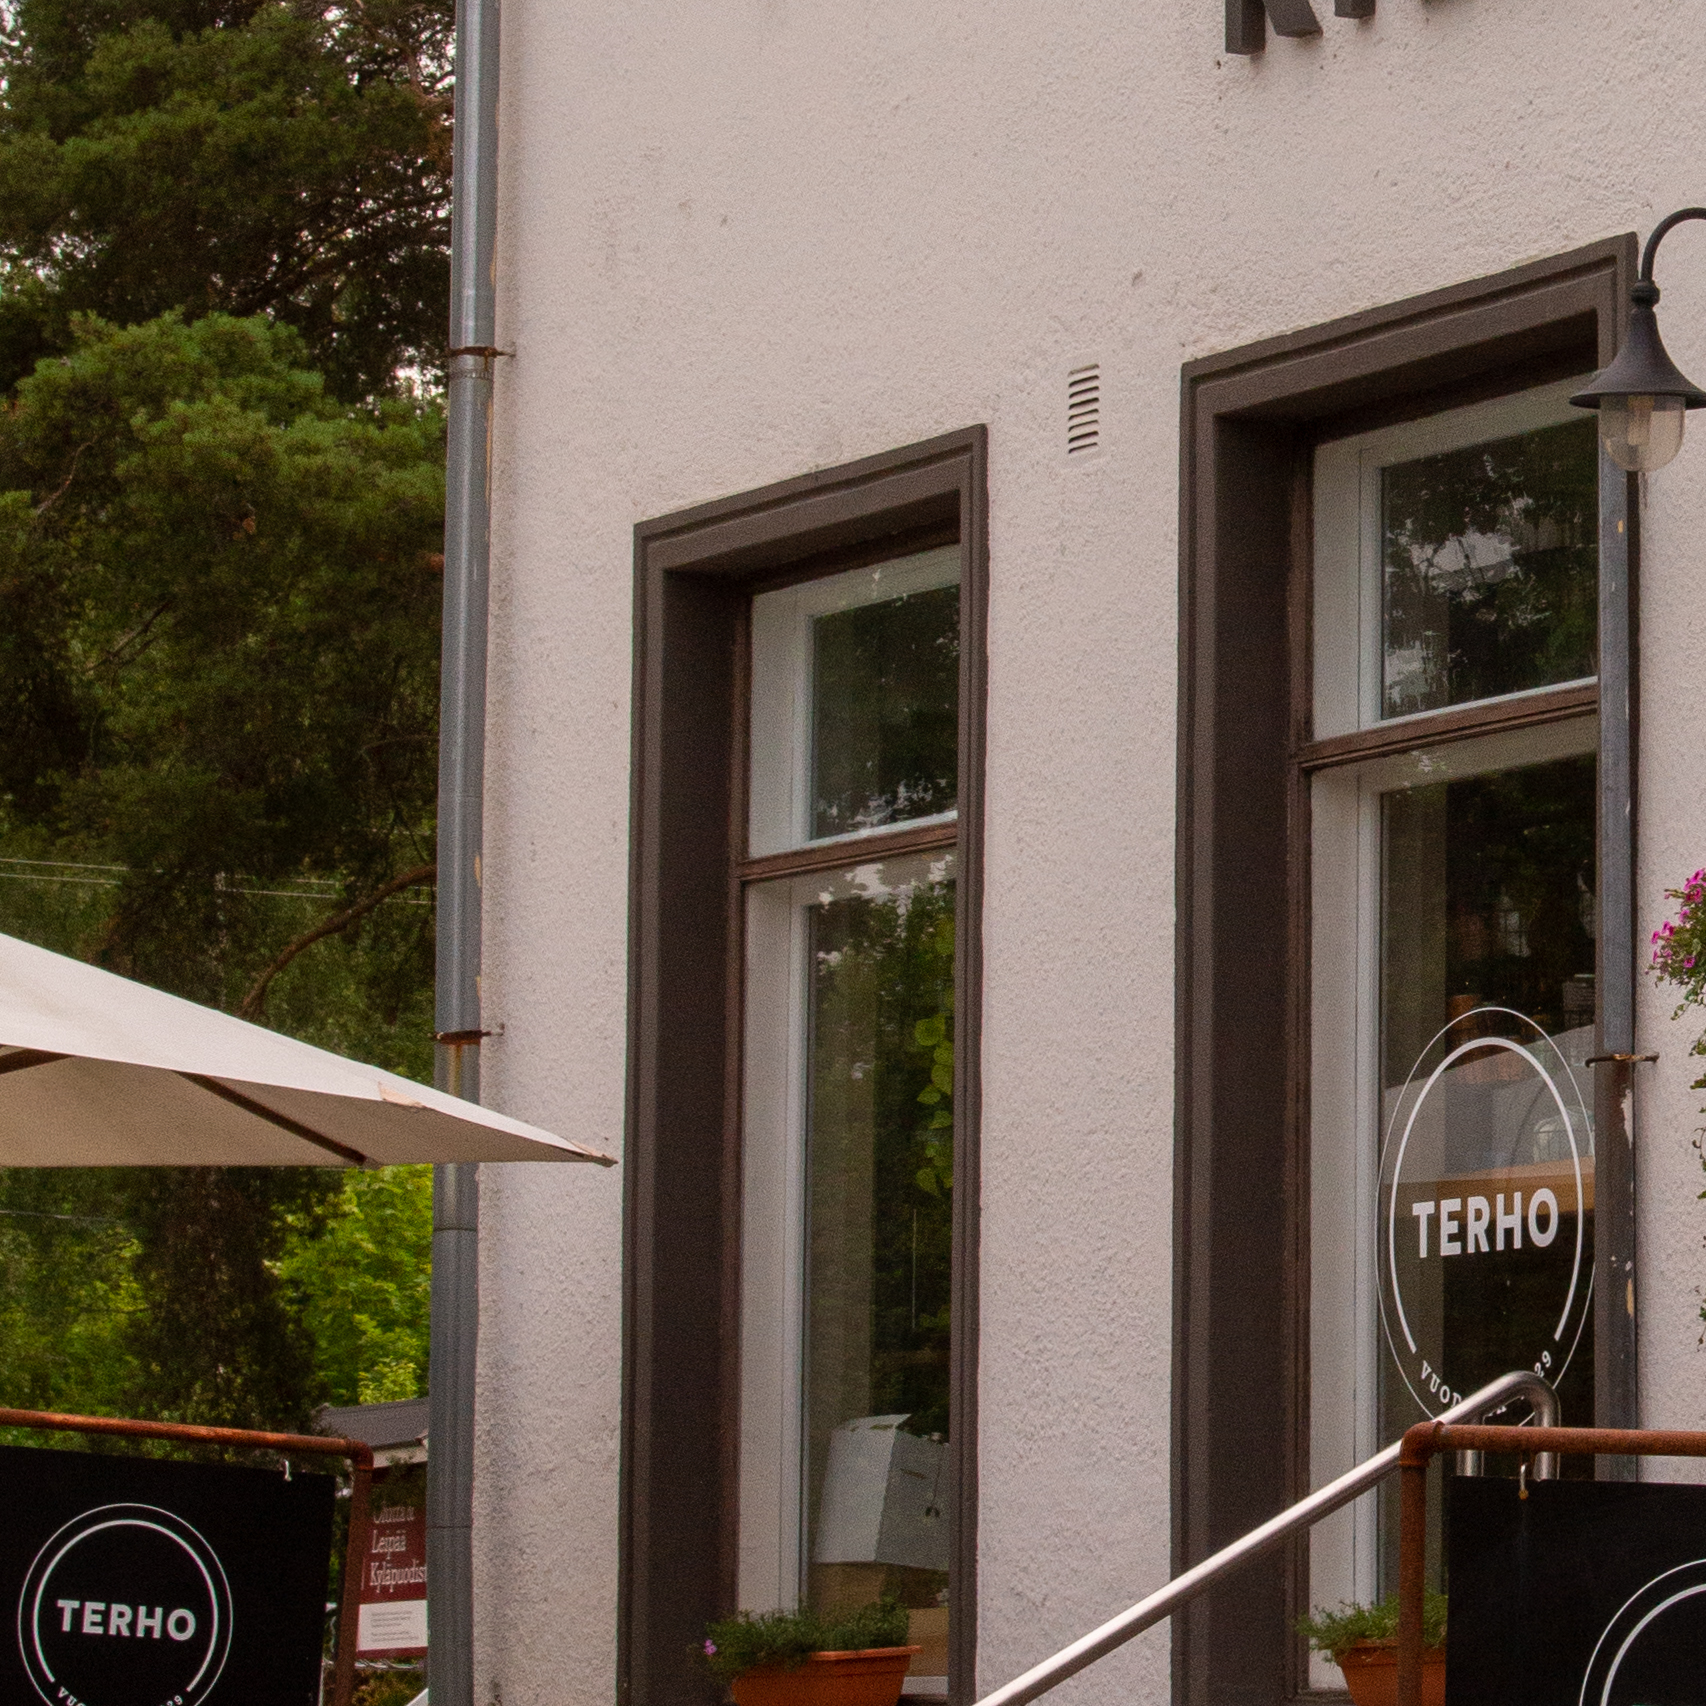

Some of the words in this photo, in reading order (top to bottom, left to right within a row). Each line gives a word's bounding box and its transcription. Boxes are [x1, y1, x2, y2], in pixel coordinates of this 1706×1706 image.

[1412, 1188, 1559, 1259] TERHO
[371, 1529, 408, 1560] Leipää
[56, 1598, 197, 1642] TERHO
